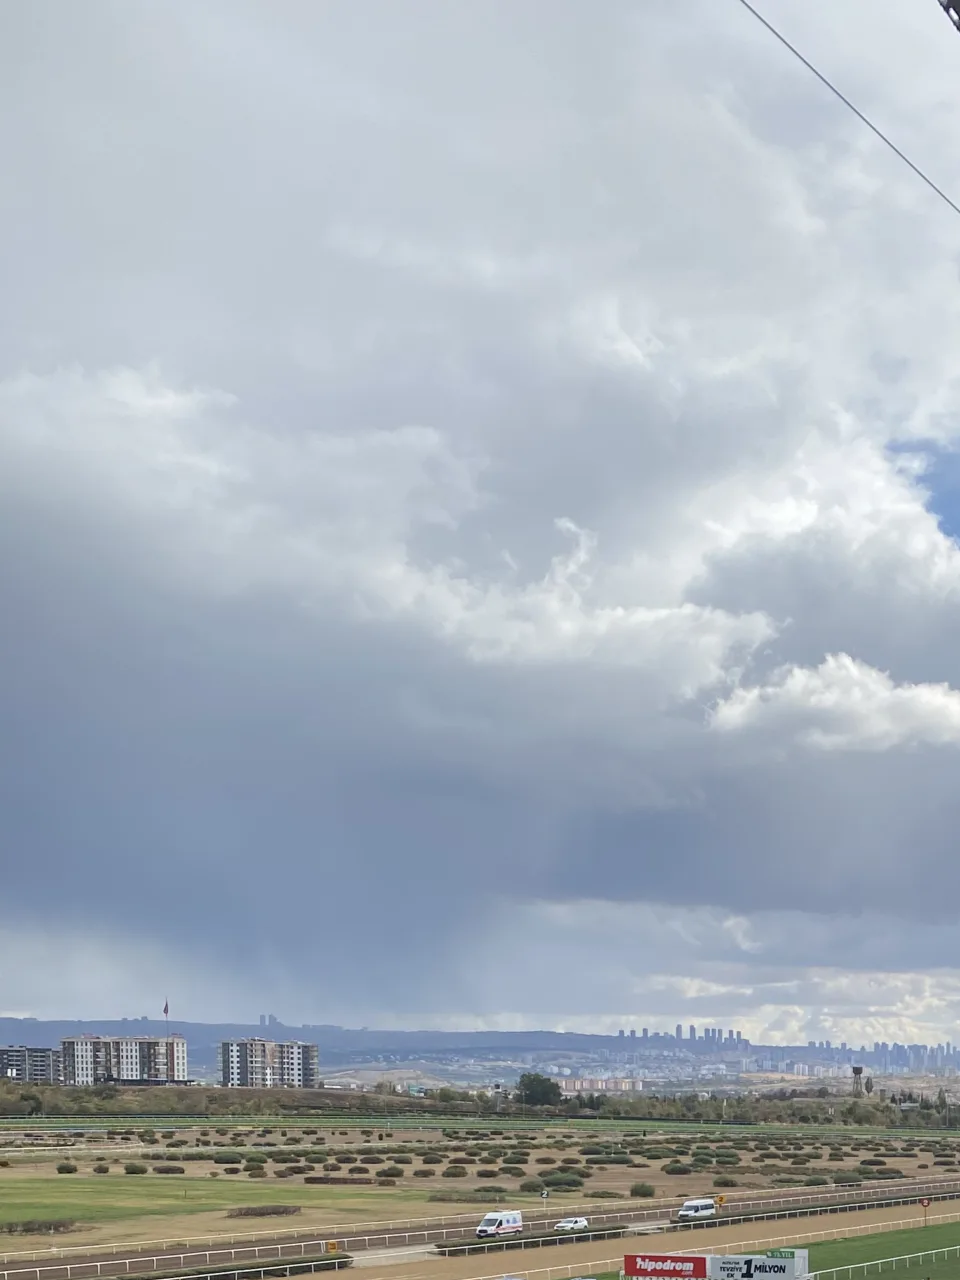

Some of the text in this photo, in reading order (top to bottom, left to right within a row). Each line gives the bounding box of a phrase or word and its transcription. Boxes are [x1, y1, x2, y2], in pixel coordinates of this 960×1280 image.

[541, 1190, 548, 1198] 2
[635, 1257, 694, 1271] hipodrom
[741, 1259, 786, 1278] 1 MİLYON
